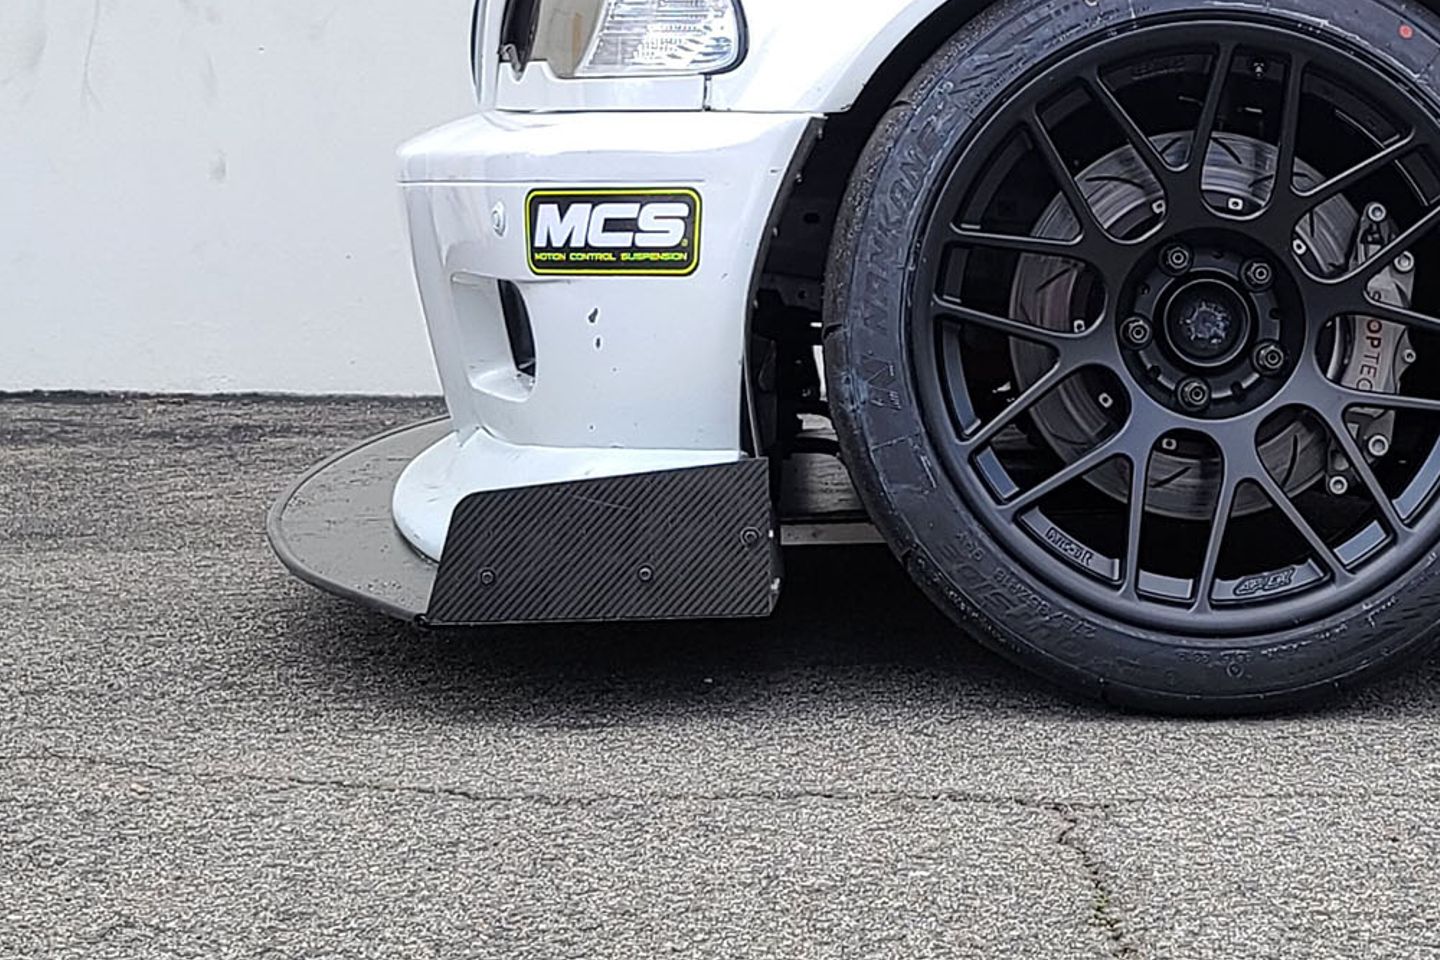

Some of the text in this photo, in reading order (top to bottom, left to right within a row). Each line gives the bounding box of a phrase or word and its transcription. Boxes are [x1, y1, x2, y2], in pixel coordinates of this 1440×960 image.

[534, 203, 690, 247] MCS
[570, 252, 616, 262] CONTROL
[621, 252, 688, 262] SUSPENSION
